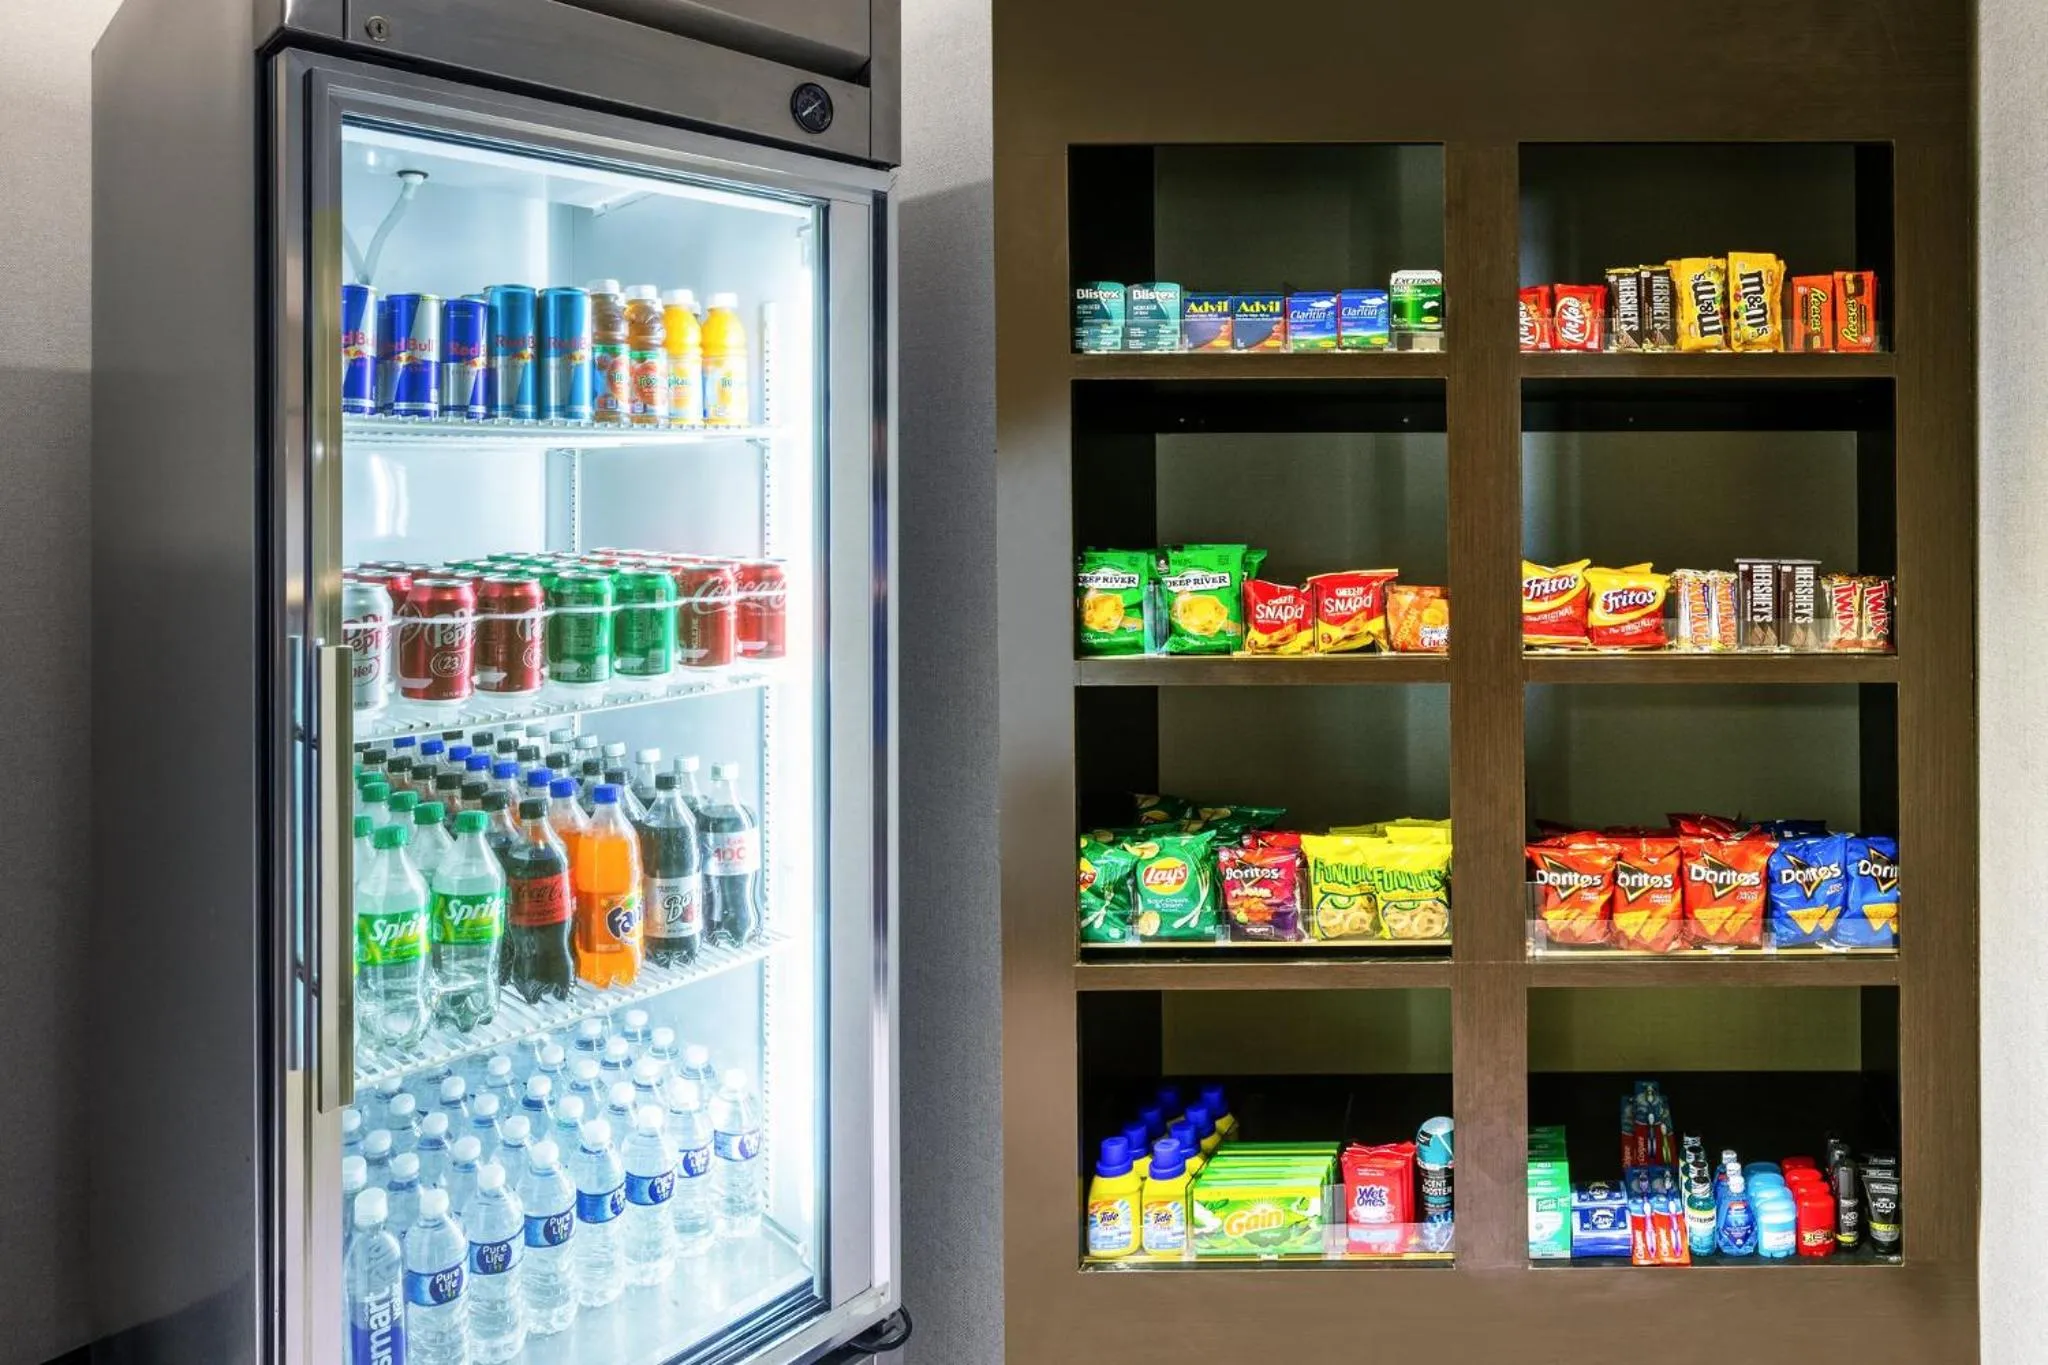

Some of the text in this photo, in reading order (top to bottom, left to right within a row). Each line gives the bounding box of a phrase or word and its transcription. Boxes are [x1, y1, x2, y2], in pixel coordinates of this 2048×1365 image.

[1076, 288, 1119, 299] Blistex
[1132, 289, 1176, 300] Blistex
[1187, 300, 1228, 313] Advil
[1238, 300, 1280, 313] Advil
[1341, 305, 1377, 317] Claritin
[1290, 308, 1326, 320] Claritin
[1103, 576, 1137, 585] RIVER
[1193, 574, 1227, 586] RIVER
[1523, 574, 1577, 600] Fritos
[1601, 589, 1656, 613] Fritos
[443, 657, 459, 670] 23
[1226, 866, 1279, 880] Doritos
[1536, 870, 1602, 887] Doritos
[1616, 870, 1673, 888] oritos
[1690, 864, 1761, 886] Doritos
[1781, 862, 1841, 884] Doritos
[1358, 1186, 1384, 1199] Wet
[1357, 1197, 1386, 1207] Ones
[1872, 1201, 1896, 1210] HOLD
[1100, 1211, 1119, 1223] Tide
[1225, 1208, 1284, 1237] Gain
[483, 1244, 508, 1255] Pure
[486, 1253, 504, 1265] Life
[436, 1268, 460, 1284] Pure
[438, 1278, 458, 1293] Life
